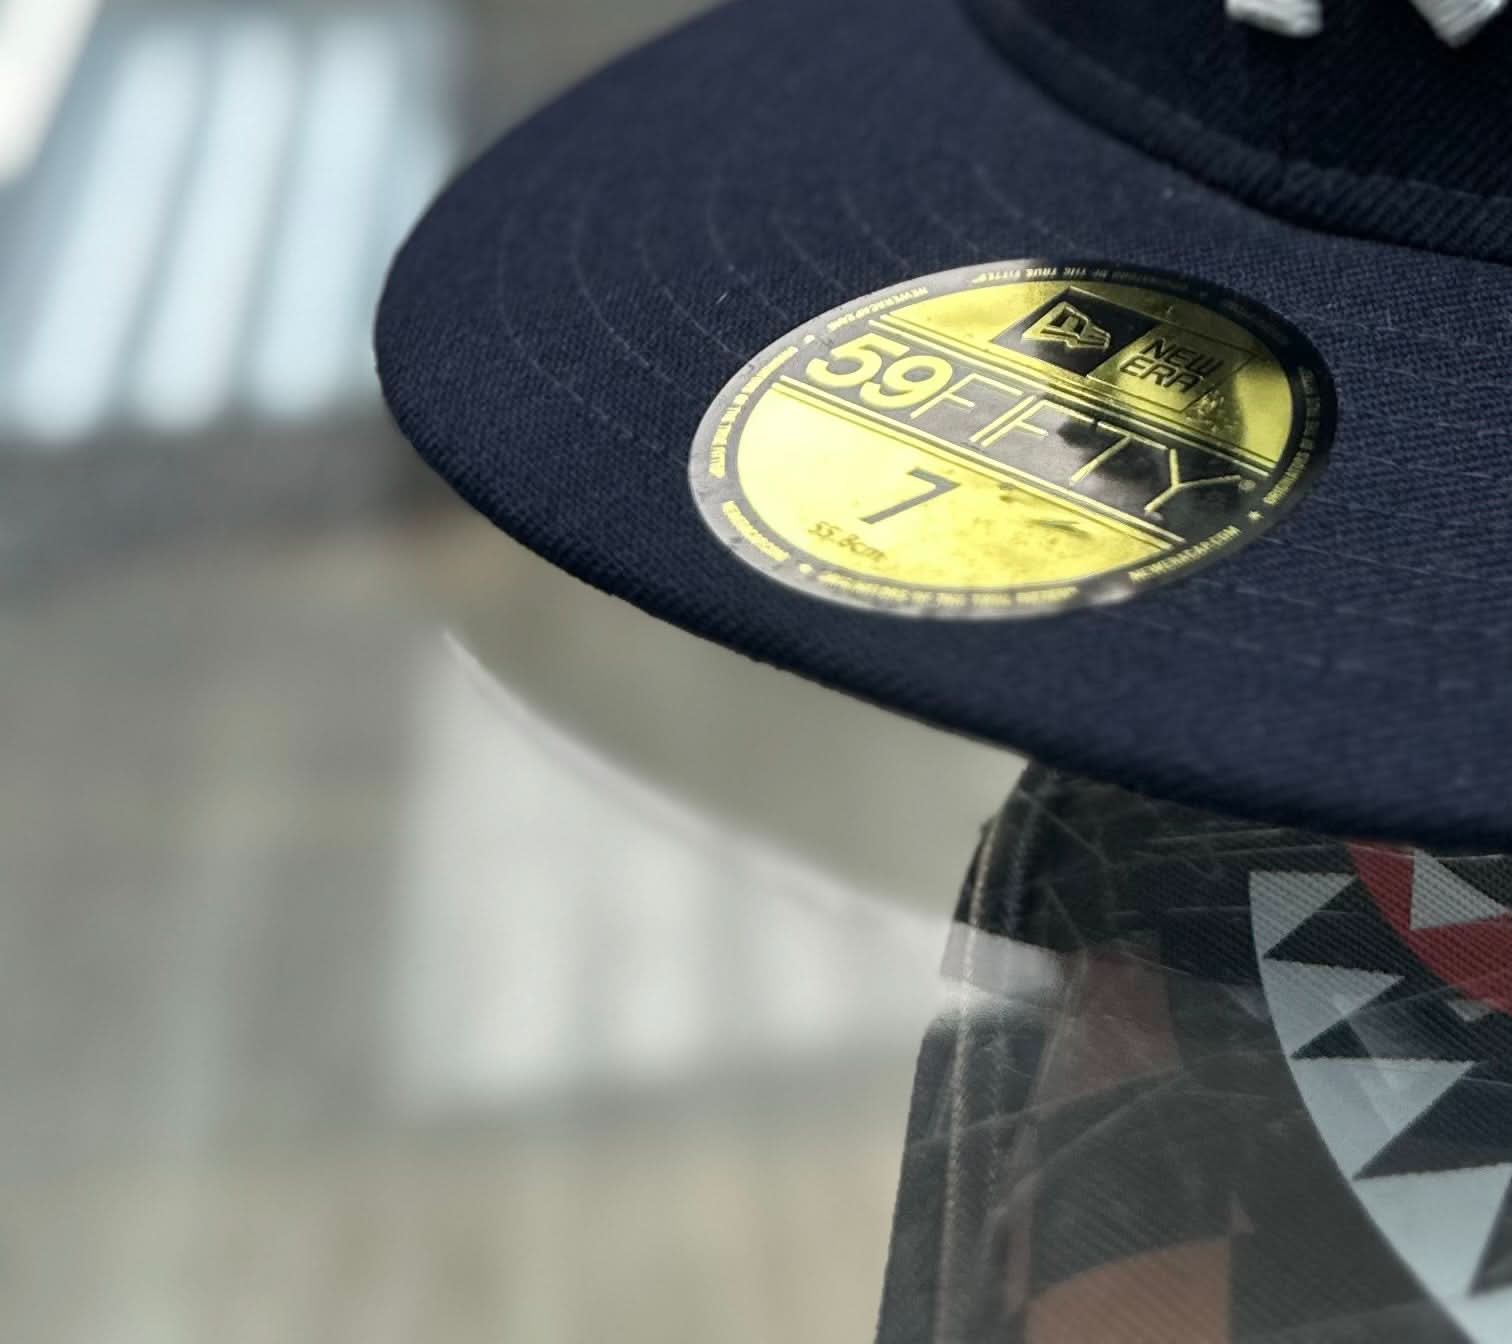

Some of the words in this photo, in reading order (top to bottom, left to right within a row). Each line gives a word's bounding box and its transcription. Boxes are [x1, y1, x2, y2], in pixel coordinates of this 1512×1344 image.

[1118, 354, 1205, 394] ERA
[1139, 336, 1225, 378] NEW
[858, 467, 962, 525] 7
